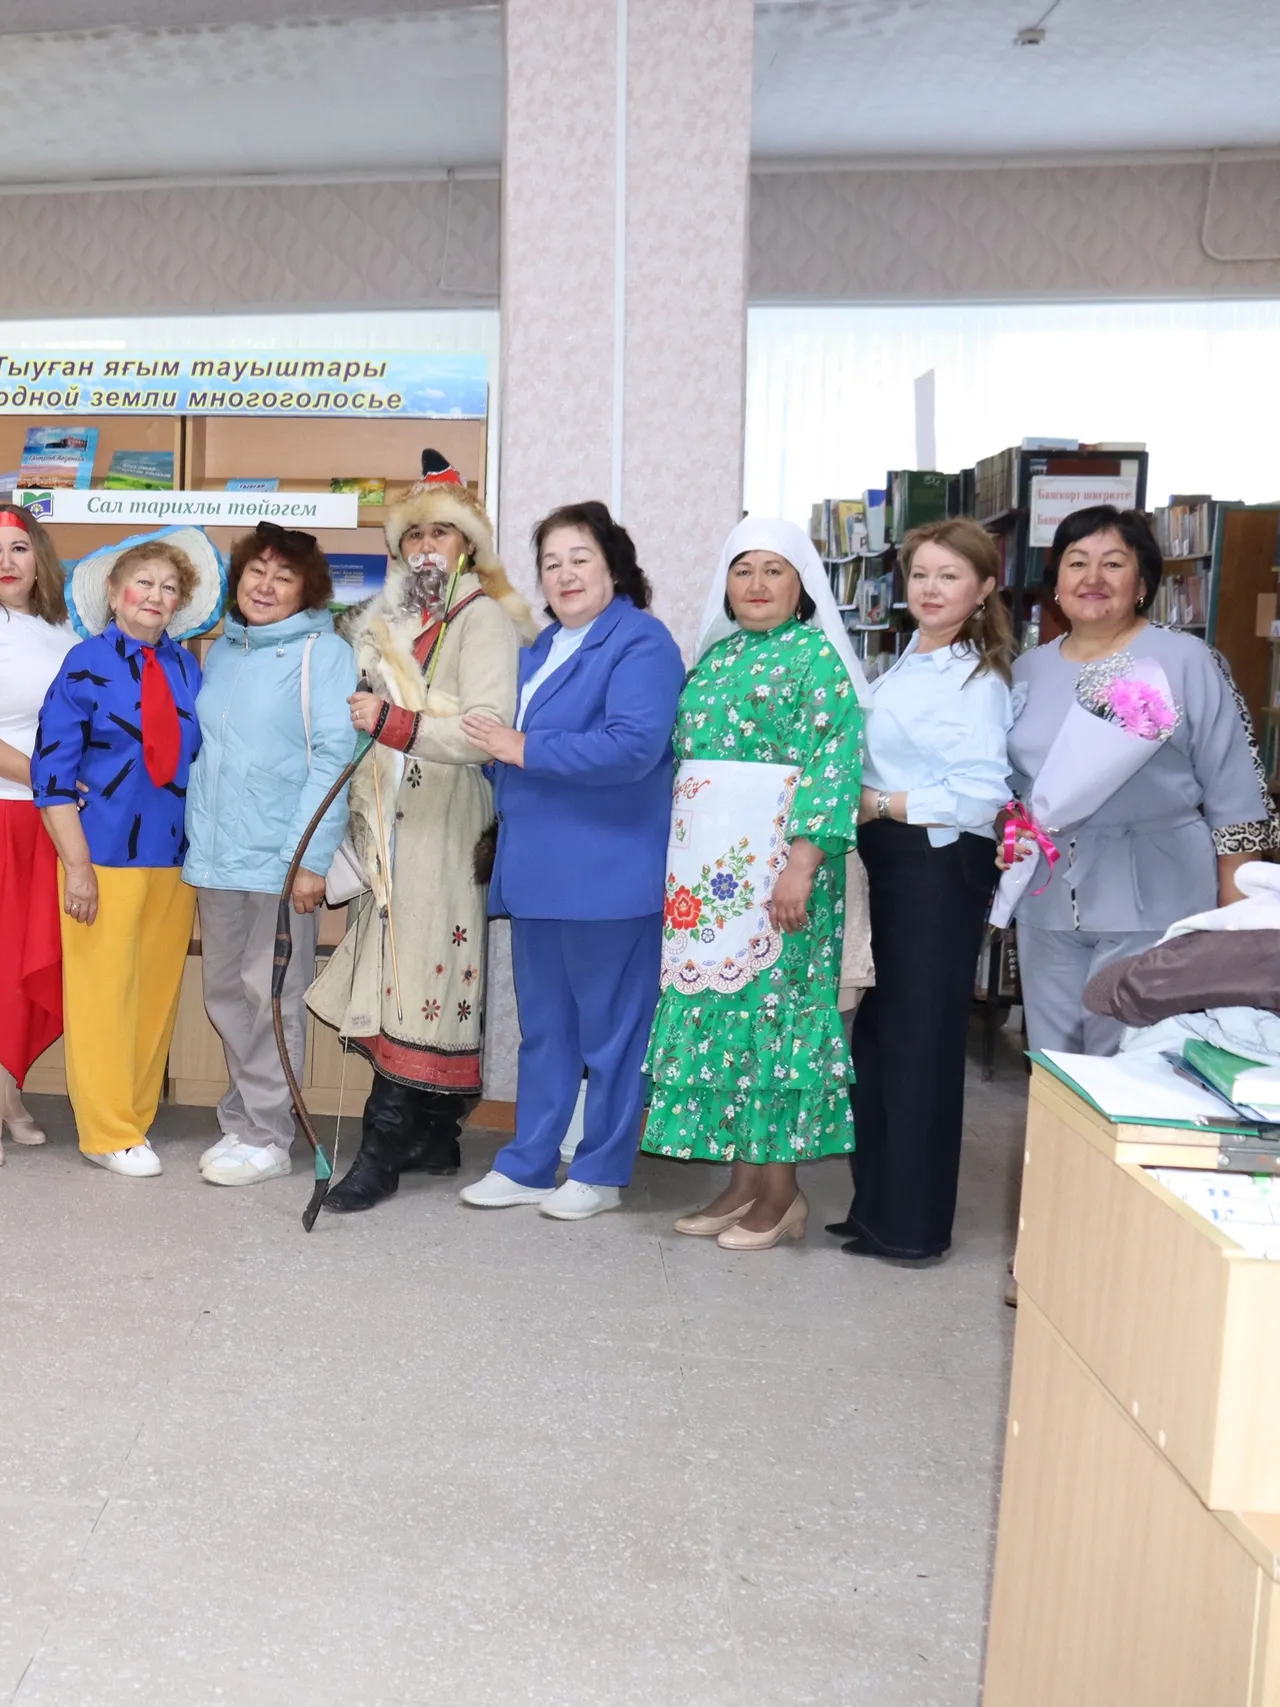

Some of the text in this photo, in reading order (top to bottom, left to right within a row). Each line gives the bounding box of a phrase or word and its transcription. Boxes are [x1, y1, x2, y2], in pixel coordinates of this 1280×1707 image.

[104, 360, 180, 376] яғым
[191, 360, 386, 383] тауыштары
[90, 390, 178, 408] земли
[188, 391, 402, 409] многоголосье
[87, 496, 318, 518] Сал тарихлы төйәгем
